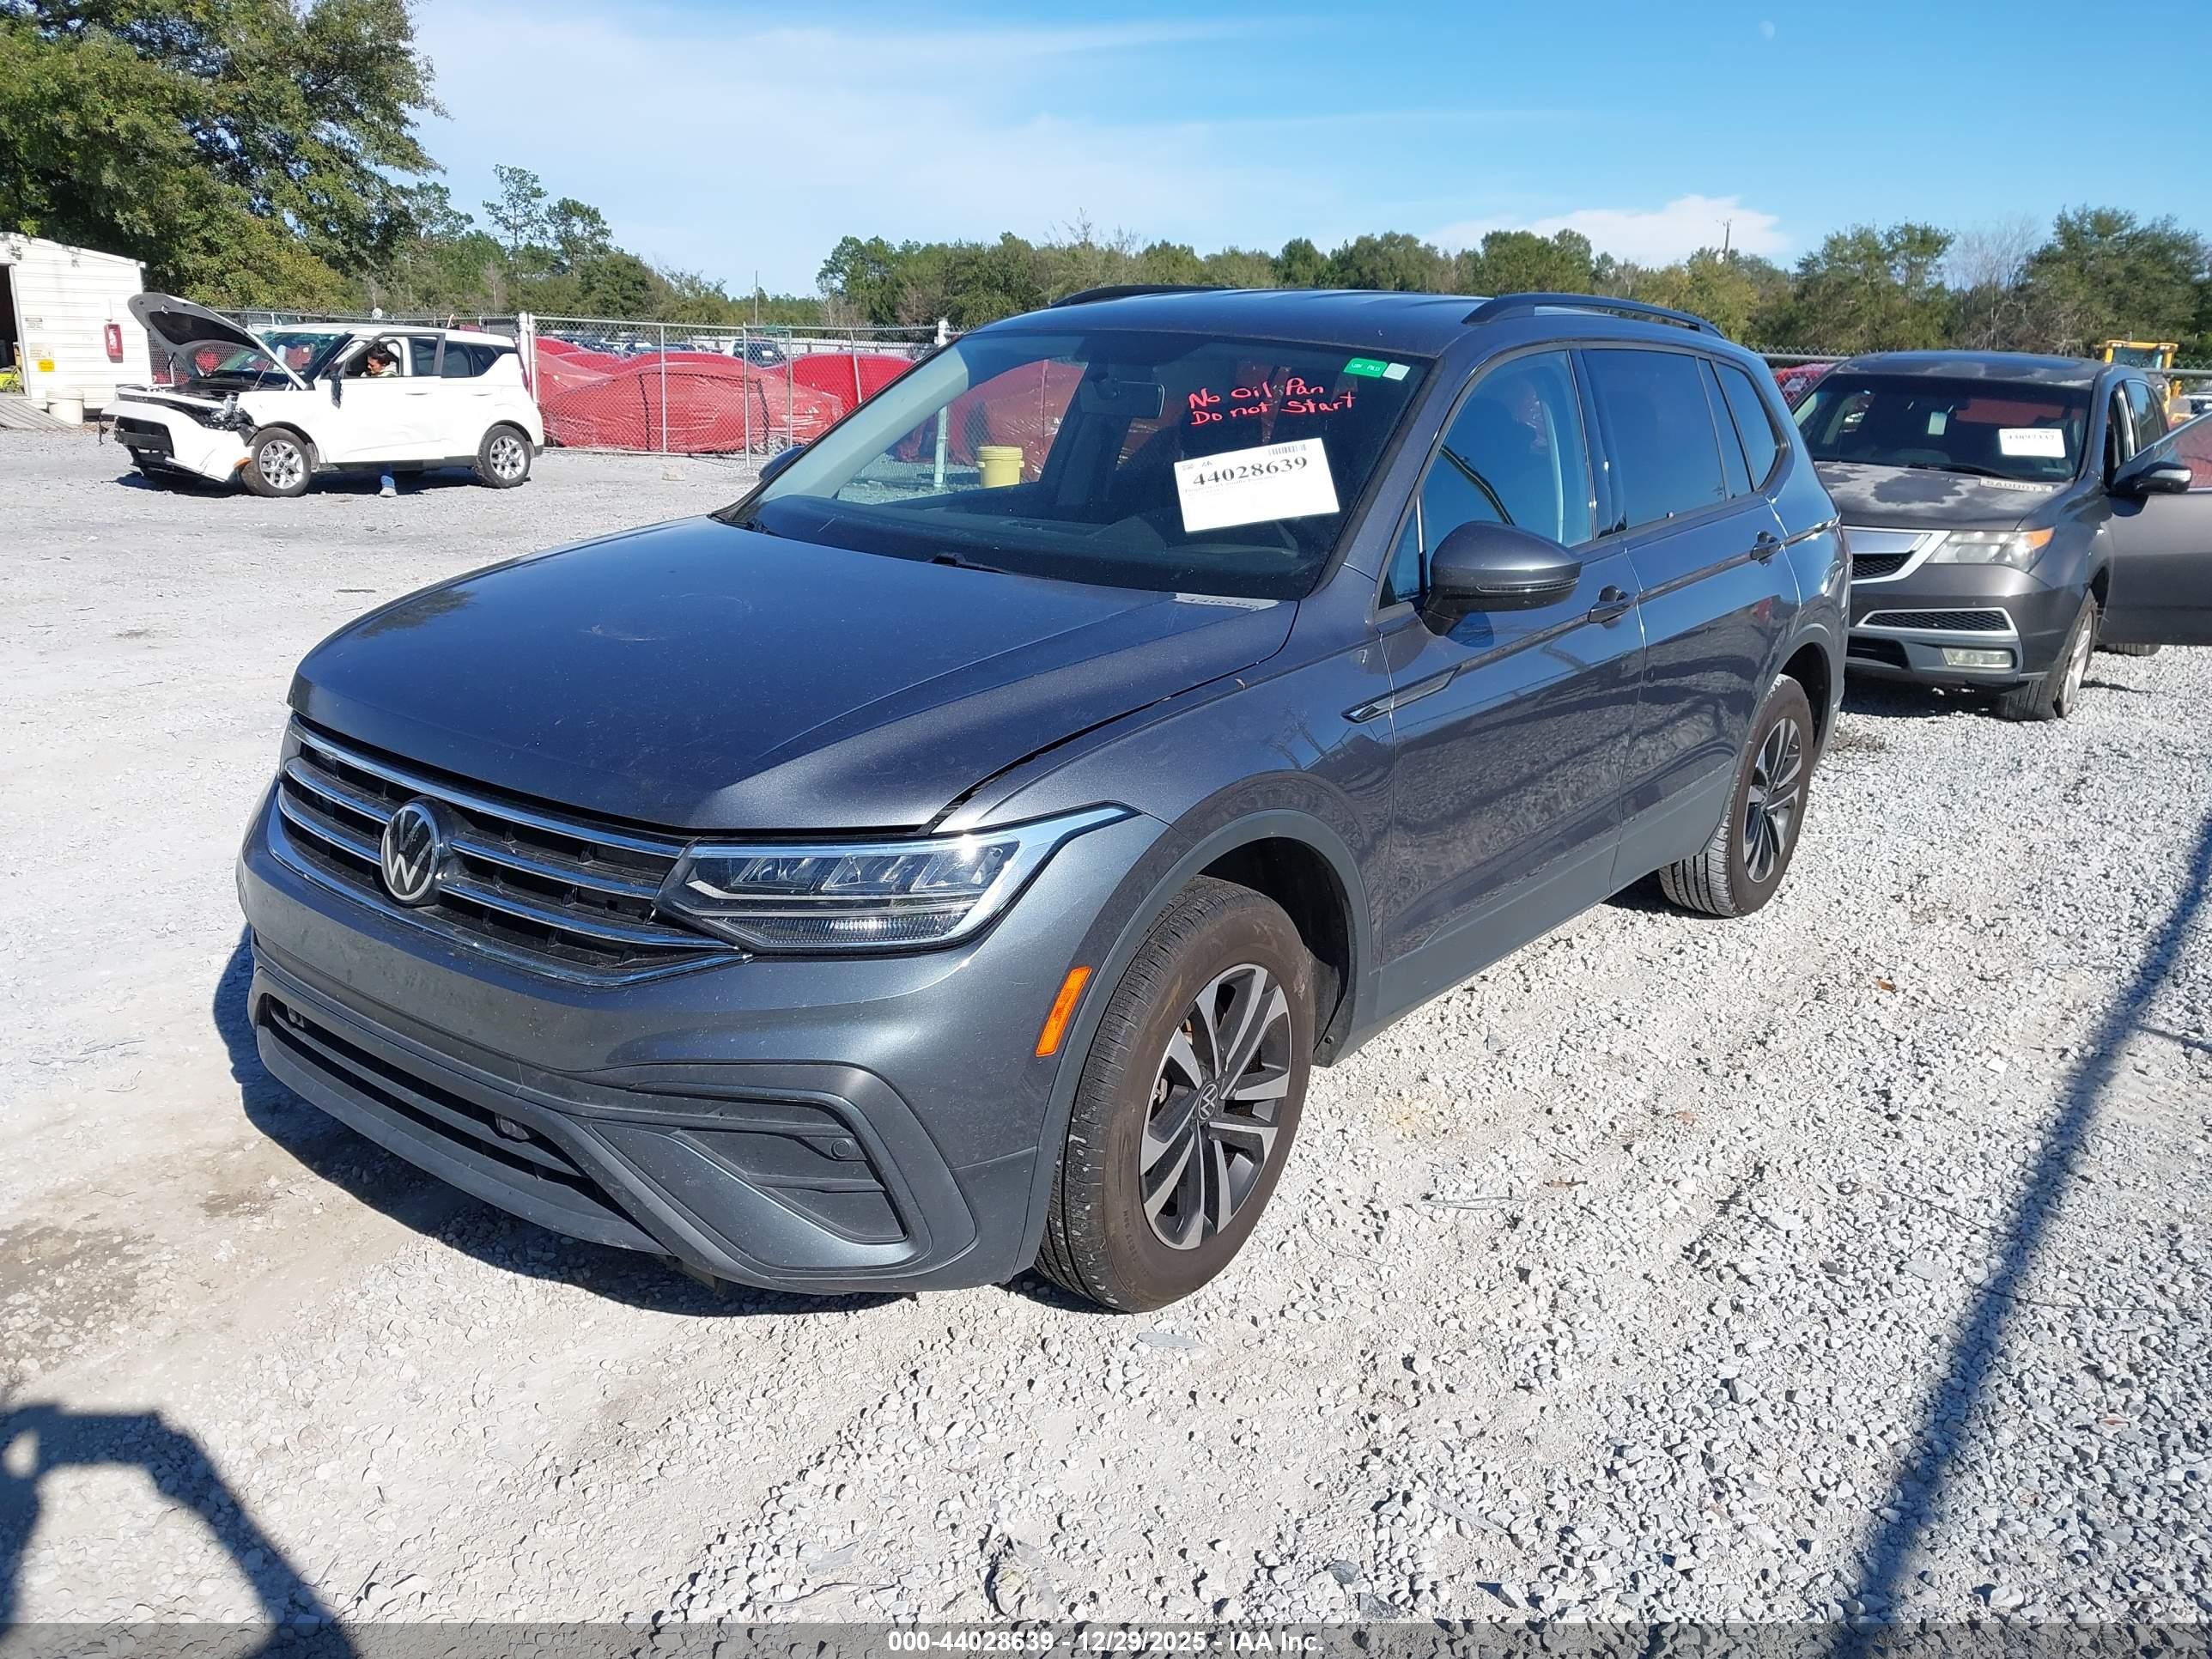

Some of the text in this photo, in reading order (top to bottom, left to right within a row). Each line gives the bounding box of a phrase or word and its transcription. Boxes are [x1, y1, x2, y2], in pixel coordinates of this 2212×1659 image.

[1188, 377, 1325, 409] No Oil Pan
[1190, 391, 1357, 426] Do not Start
[1193, 456, 1308, 485] 44028639
